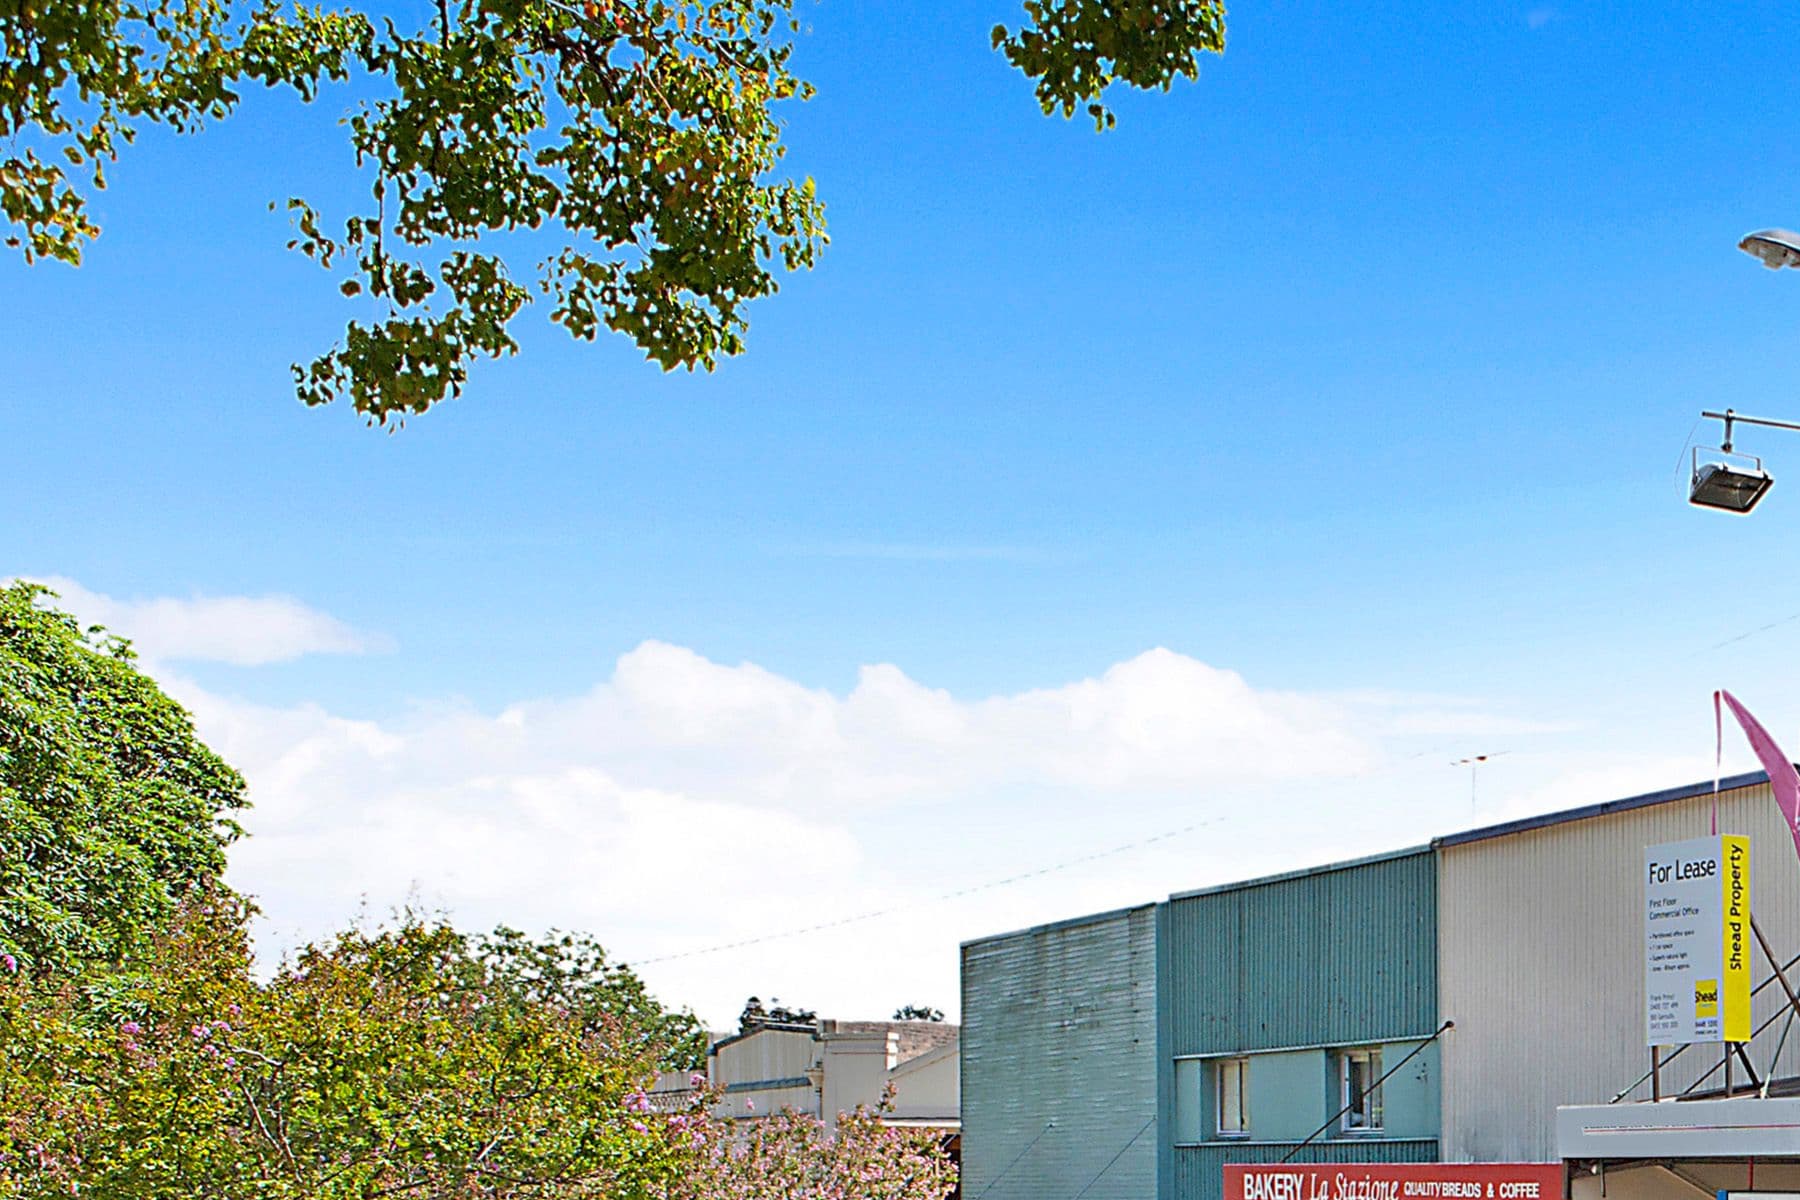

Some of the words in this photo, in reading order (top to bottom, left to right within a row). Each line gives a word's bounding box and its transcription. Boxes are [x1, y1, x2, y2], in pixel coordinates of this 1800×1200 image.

[1649, 862, 1673, 884] For
[1676, 859, 1716, 880] Lease
[1730, 844, 1744, 916] Property
[1730, 921, 1742, 970] Shead
[1243, 1173, 1304, 1200] BAKERY
[1403, 1181, 1441, 1198] QUALITY
[1442, 1182, 1482, 1198] BREADS
[1487, 1182, 1495, 1198] &
[1499, 1182, 1540, 1199] COFFEE
